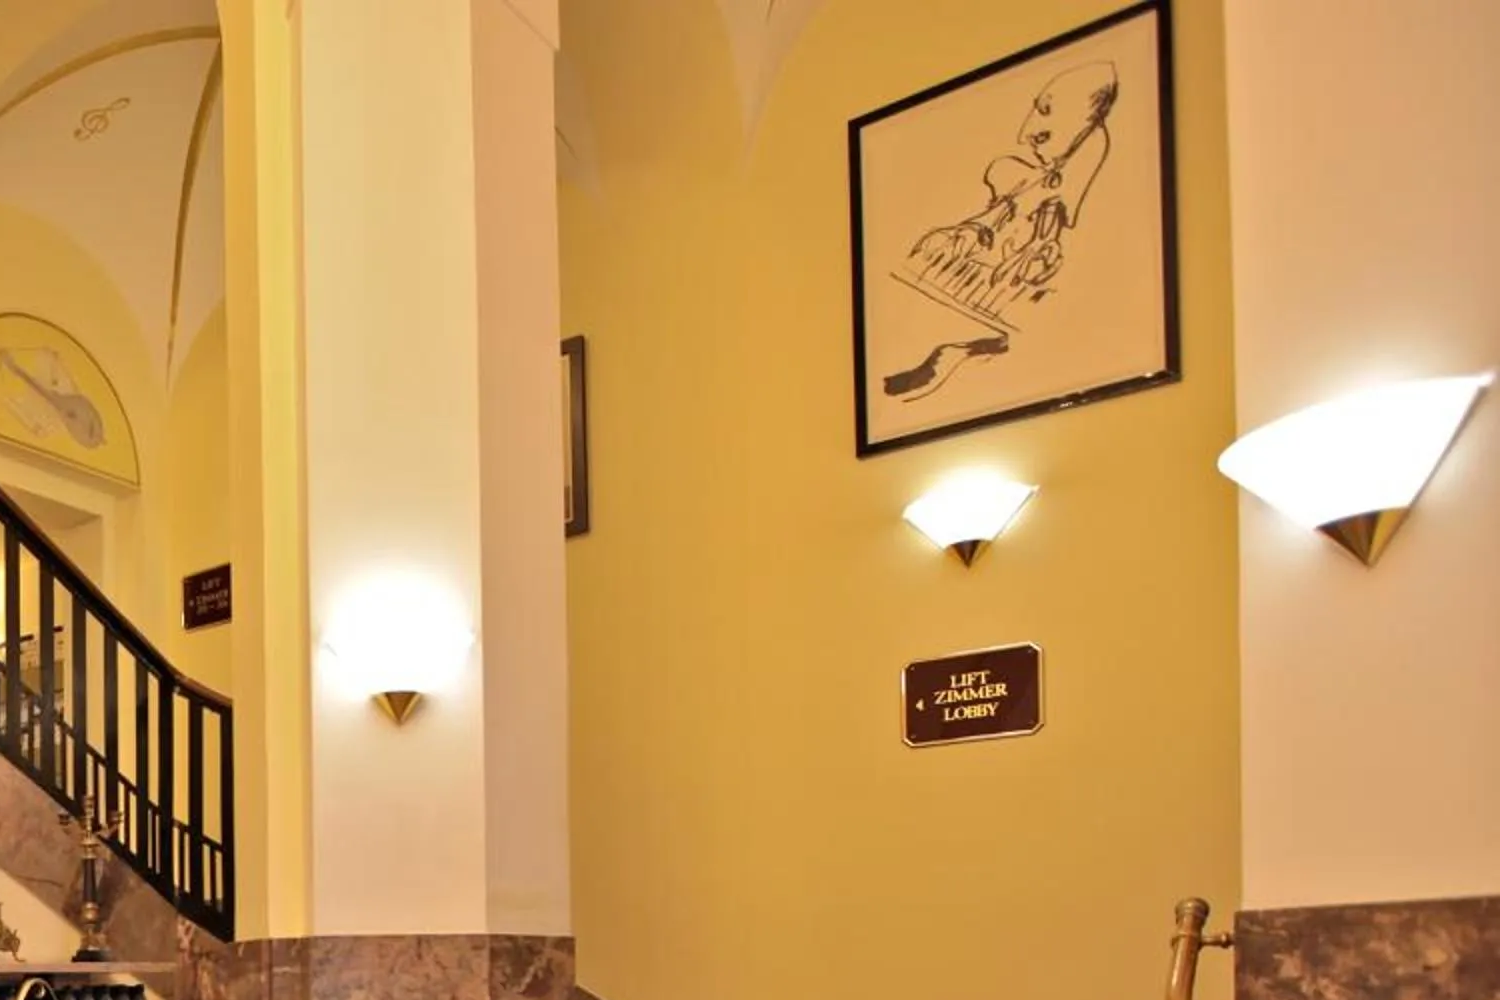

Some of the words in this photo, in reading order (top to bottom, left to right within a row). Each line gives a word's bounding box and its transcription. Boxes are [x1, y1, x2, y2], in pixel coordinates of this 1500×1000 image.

[950, 670, 991, 688] LIFT
[934, 683, 1008, 705] ZIMMER
[943, 702, 999, 722] LOBBY
